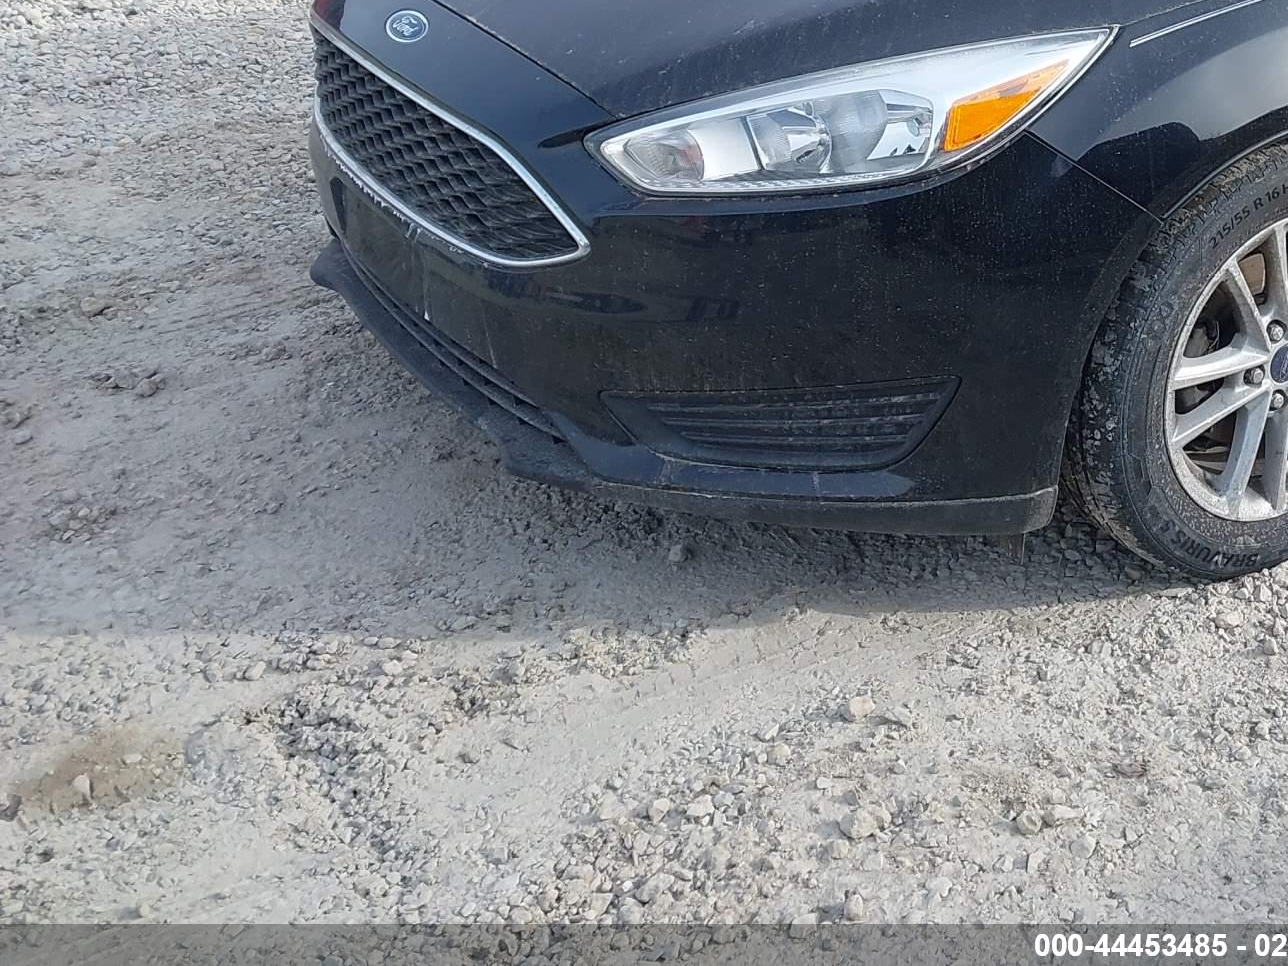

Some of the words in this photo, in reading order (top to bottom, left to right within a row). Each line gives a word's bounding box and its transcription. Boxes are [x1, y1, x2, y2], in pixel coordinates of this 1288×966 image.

[1208, 208, 1250, 249] 215/55
[1253, 198, 1265, 211] R
[1265, 188, 1281, 203] 16
[1170, 530, 1260, 568] BRAVURIS
